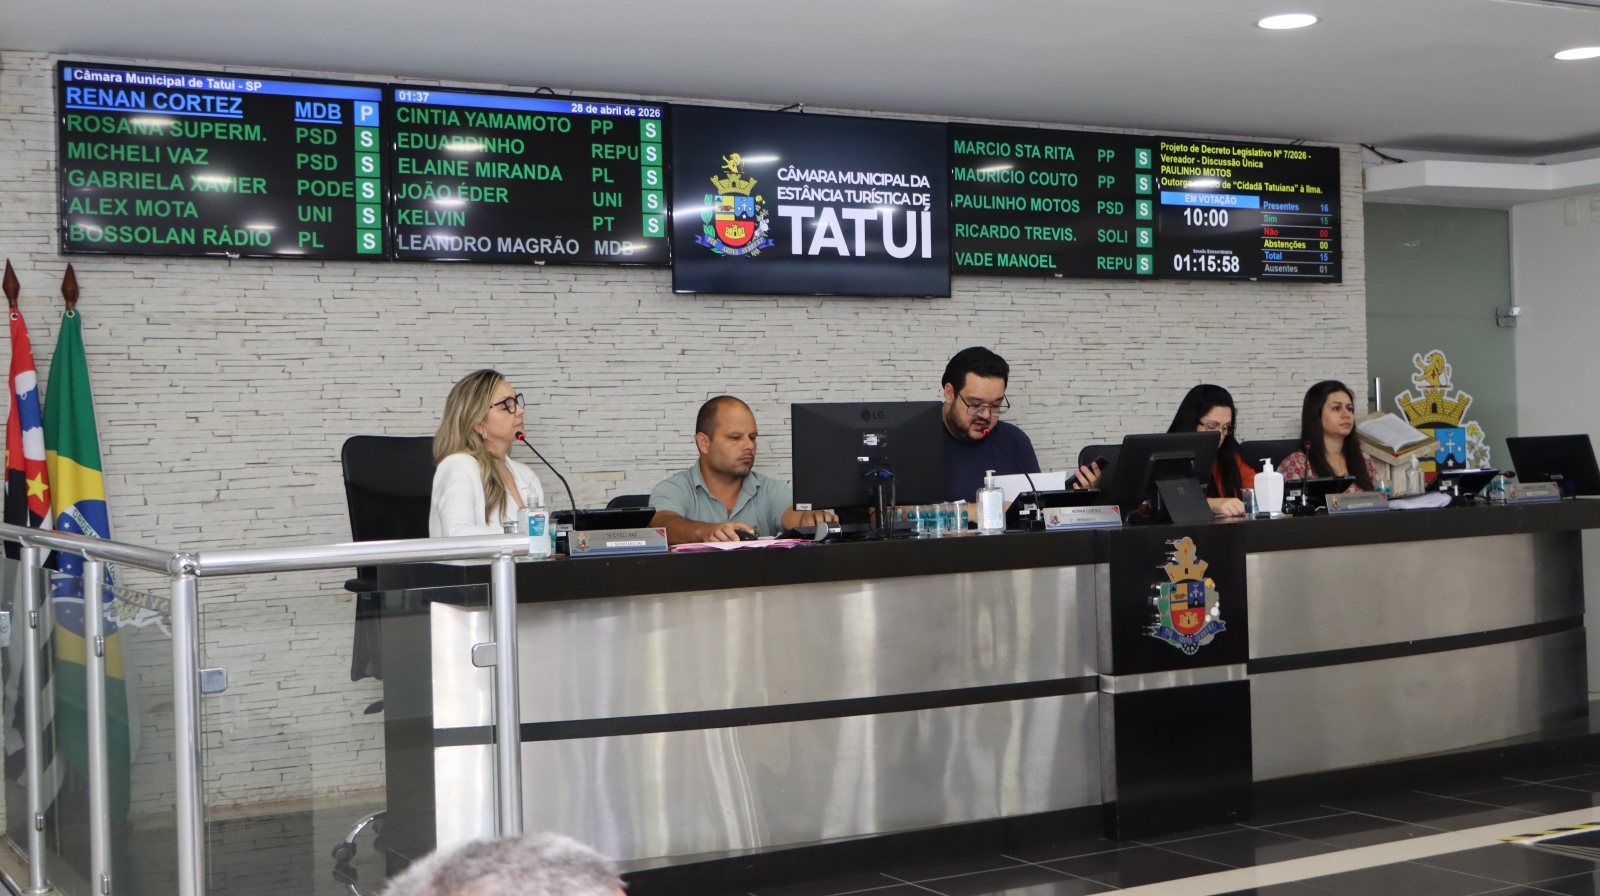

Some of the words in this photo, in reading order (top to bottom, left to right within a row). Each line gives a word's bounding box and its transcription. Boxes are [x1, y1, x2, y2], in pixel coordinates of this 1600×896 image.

[74, 69, 122, 84] Câmara
[126, 72, 185, 89] Municipal
[189, 76, 203, 88] de
[205, 78, 235, 90] Tatuí
[245, 80, 262, 92] SP
[66, 87, 145, 108] RENAN
[152, 92, 243, 114] CORTEZ
[295, 101, 342, 120] MDB
[361, 105, 373, 120] P
[399, 91, 429, 102] 01:37
[571, 103, 583, 113] 28
[585, 104, 598, 114] de
[600, 105, 622, 116] abril
[624, 107, 636, 116] de
[638, 108, 660, 118] 2026
[67, 115, 164, 137] ROSANA
[170, 120, 267, 141] SUPERM.
[296, 128, 337, 145] PSD
[360, 131, 374, 148] S
[397, 107, 460, 126] CINTIA
[465, 111, 571, 132] YAMAMOTO
[591, 120, 613, 135] PP
[645, 123, 656, 137] S
[68, 142, 160, 163] MICHELI
[167, 147, 208, 165] VAZ
[297, 154, 337, 171] PSD
[361, 156, 374, 173] S
[398, 133, 525, 154] EDUARDINHO
[592, 144, 638, 160] REPU
[646, 147, 657, 162] S
[954, 140, 1010, 156] MARCIO
[1015, 144, 1041, 158] STA
[1045, 146, 1074, 160] RITA
[1098, 150, 1114, 162] PP
[1139, 152, 1148, 165] S
[1160, 142, 1188, 153] Projeto
[1202, 145, 1230, 155] Decreto
[1232, 147, 1272, 158] Legislativo
[1284, 150, 1306, 160] 7/2026
[1160, 154, 1195, 164] Vereador
[1202, 157, 1240, 167] Discussão
[1242, 158, 1263, 168] Única
[398, 158, 468, 176] ELAINE
[476, 162, 562, 181] MIRANDA
[592, 168, 614, 183] PL
[646, 170, 658, 185] S
[777, 165, 837, 183] CÂMARA
[839, 171, 909, 187] MUNICIPAL
[910, 175, 930, 188] DA
[1029, 171, 1078, 187] COUTO
[1098, 176, 1115, 188] PP
[1140, 178, 1148, 190] S
[1161, 166, 1201, 176] PAULINHO
[1203, 168, 1231, 177] MOTOS
[68, 170, 184, 192] GABRIELA
[190, 176, 267, 194] XAVIER
[298, 180, 354, 198] PODE
[362, 182, 375, 199] S
[1222, 181, 1231, 189] de
[397, 183, 451, 200] JOÃO
[458, 182, 509, 202] ÉDER
[593, 192, 622, 208] UNI
[647, 194, 658, 209] S
[778, 184, 843, 202] ESTÂNCIA
[845, 187, 911, 205] TURÍSTICA
[913, 194, 930, 206] DE
[955, 194, 1026, 210] PAULINHO
[1031, 198, 1080, 213] MOTOS
[1098, 201, 1124, 214] PSD
[1140, 203, 1148, 216] S
[1186, 194, 1197, 203] EM
[1199, 194, 1236, 206] VOTAÇÃO
[69, 198, 128, 216] ALEX
[136, 201, 198, 218] MOTA
[298, 206, 332, 222] UNI
[362, 208, 375, 224] S
[1264, 201, 1299, 211] Presentes
[398, 210, 466, 226] KELVIN
[593, 217, 614, 231] PT
[648, 218, 658, 233] S
[1184, 208, 1228, 227] 10:00
[1264, 214, 1277, 223] Sim
[69, 226, 195, 245] BOSSOLAN
[203, 226, 271, 247] RÁDIO
[299, 232, 324, 248] PL
[363, 233, 376, 250] S
[778, 205, 931, 259] TATUÍ
[956, 224, 1020, 239] RICARDO
[1025, 226, 1076, 241] TREVIS.
[1098, 229, 1127, 243] SOLI
[1140, 231, 1148, 244] S
[399, 235, 492, 252] LEANDRO
[498, 236, 580, 255] MAGRÃO
[595, 241, 634, 256] MDB
[1264, 239, 1306, 249] Abstenções
[955, 252, 993, 266] VADE
[998, 253, 1057, 268] MANOEL
[1098, 257, 1132, 270] REPU
[1140, 258, 1149, 271] S
[1174, 254, 1240, 273] 01:15:58
[1265, 252, 1282, 260] Total
[1265, 264, 1298, 272] Ausentes
[872, 411, 884, 419] LG
